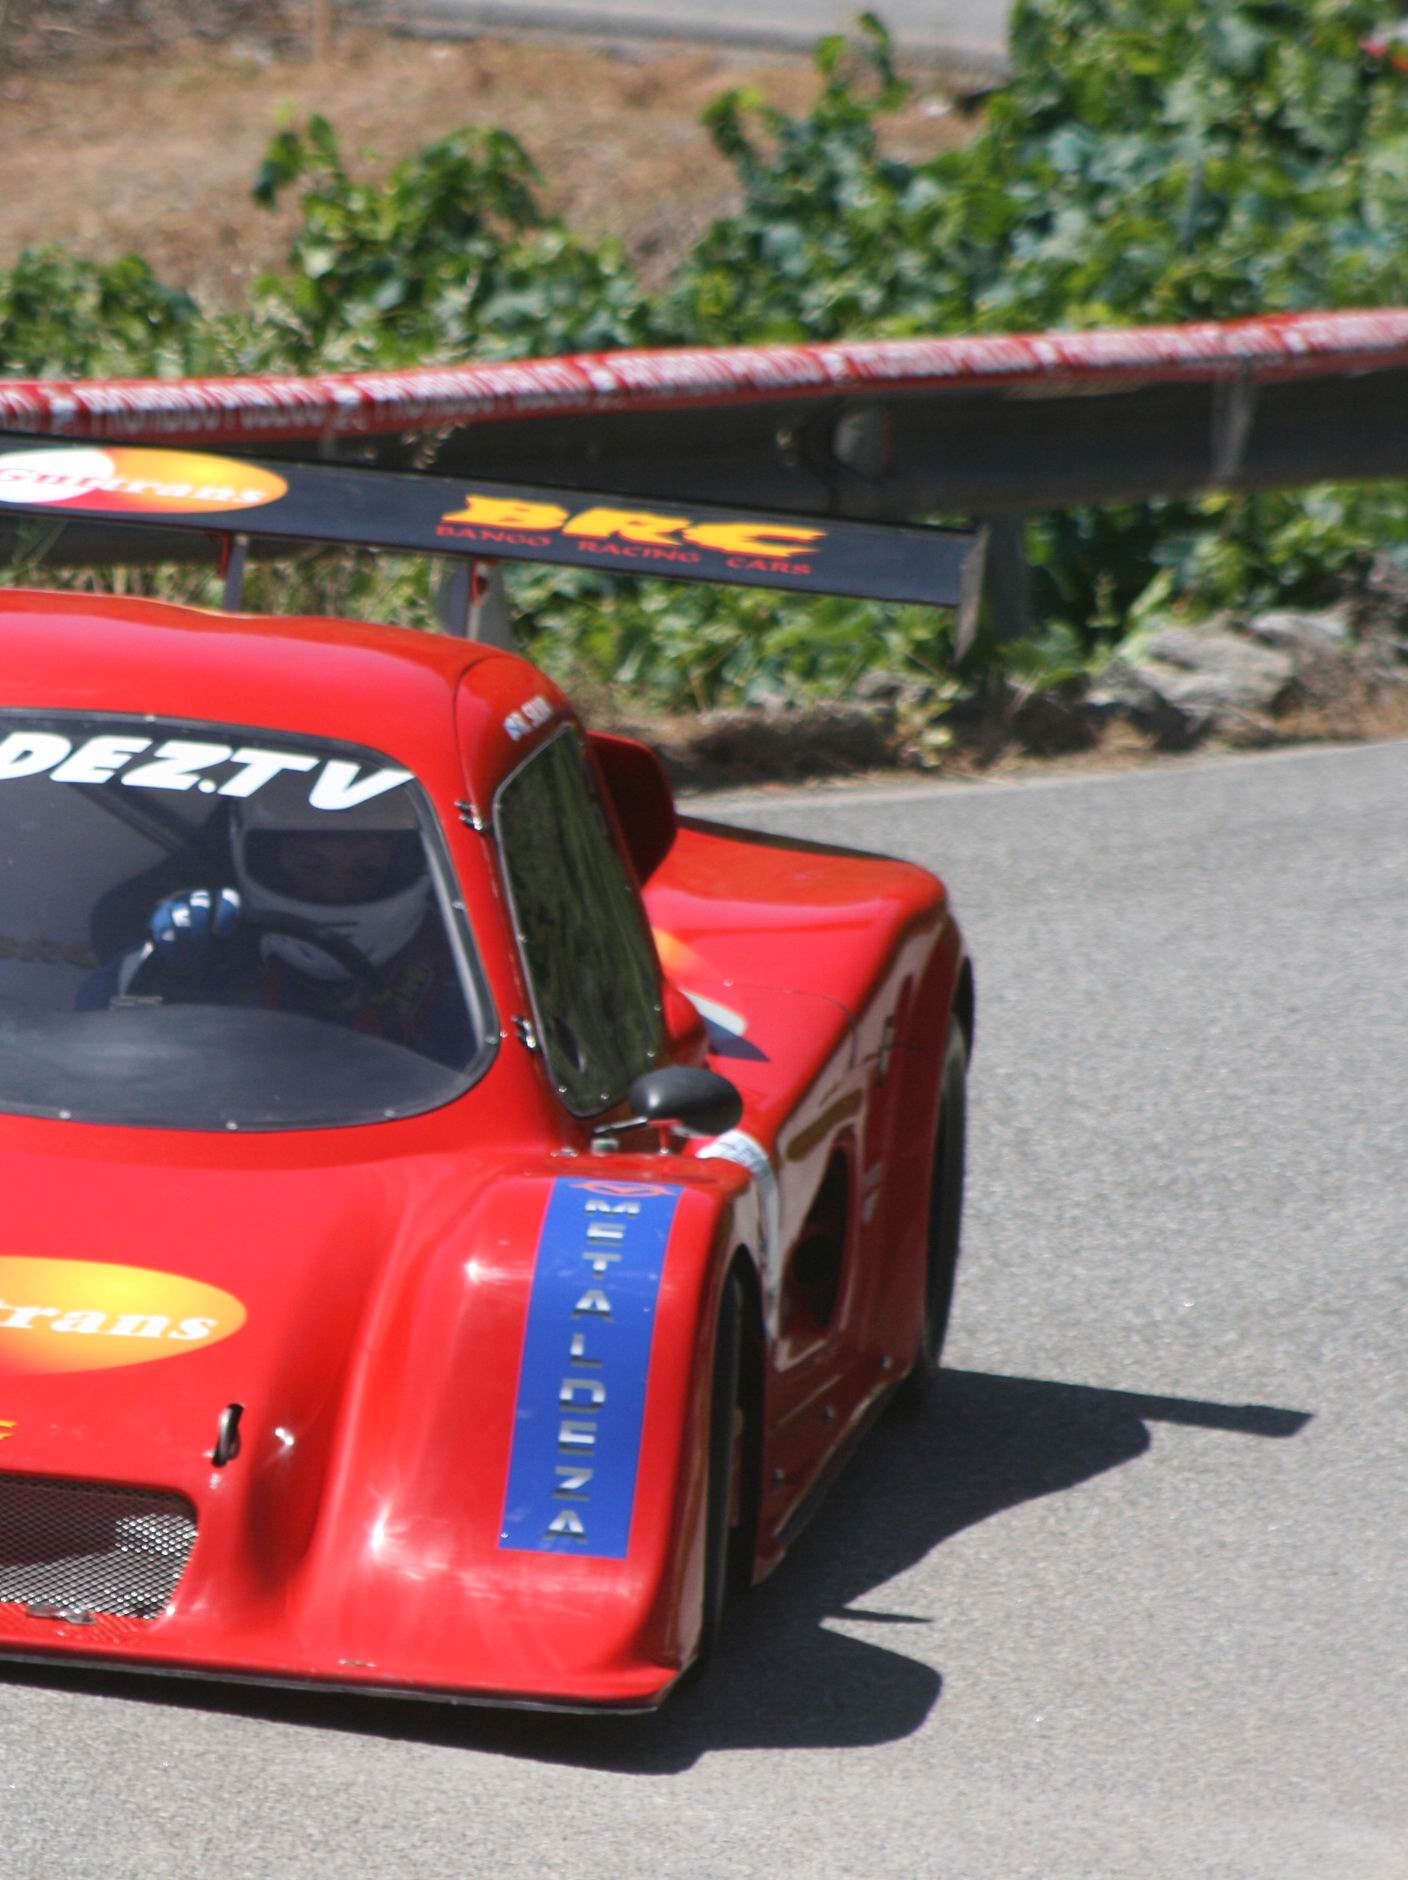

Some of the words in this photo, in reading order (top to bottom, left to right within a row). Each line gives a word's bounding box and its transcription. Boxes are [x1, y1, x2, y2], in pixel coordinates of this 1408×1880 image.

[435, 525, 552, 547] BANGO
[577, 540, 701, 564] RACING
[725, 556, 815, 576] CARS
[441, 495, 830, 559] BRC
[543, 1198, 641, 1545] METALDEZA
